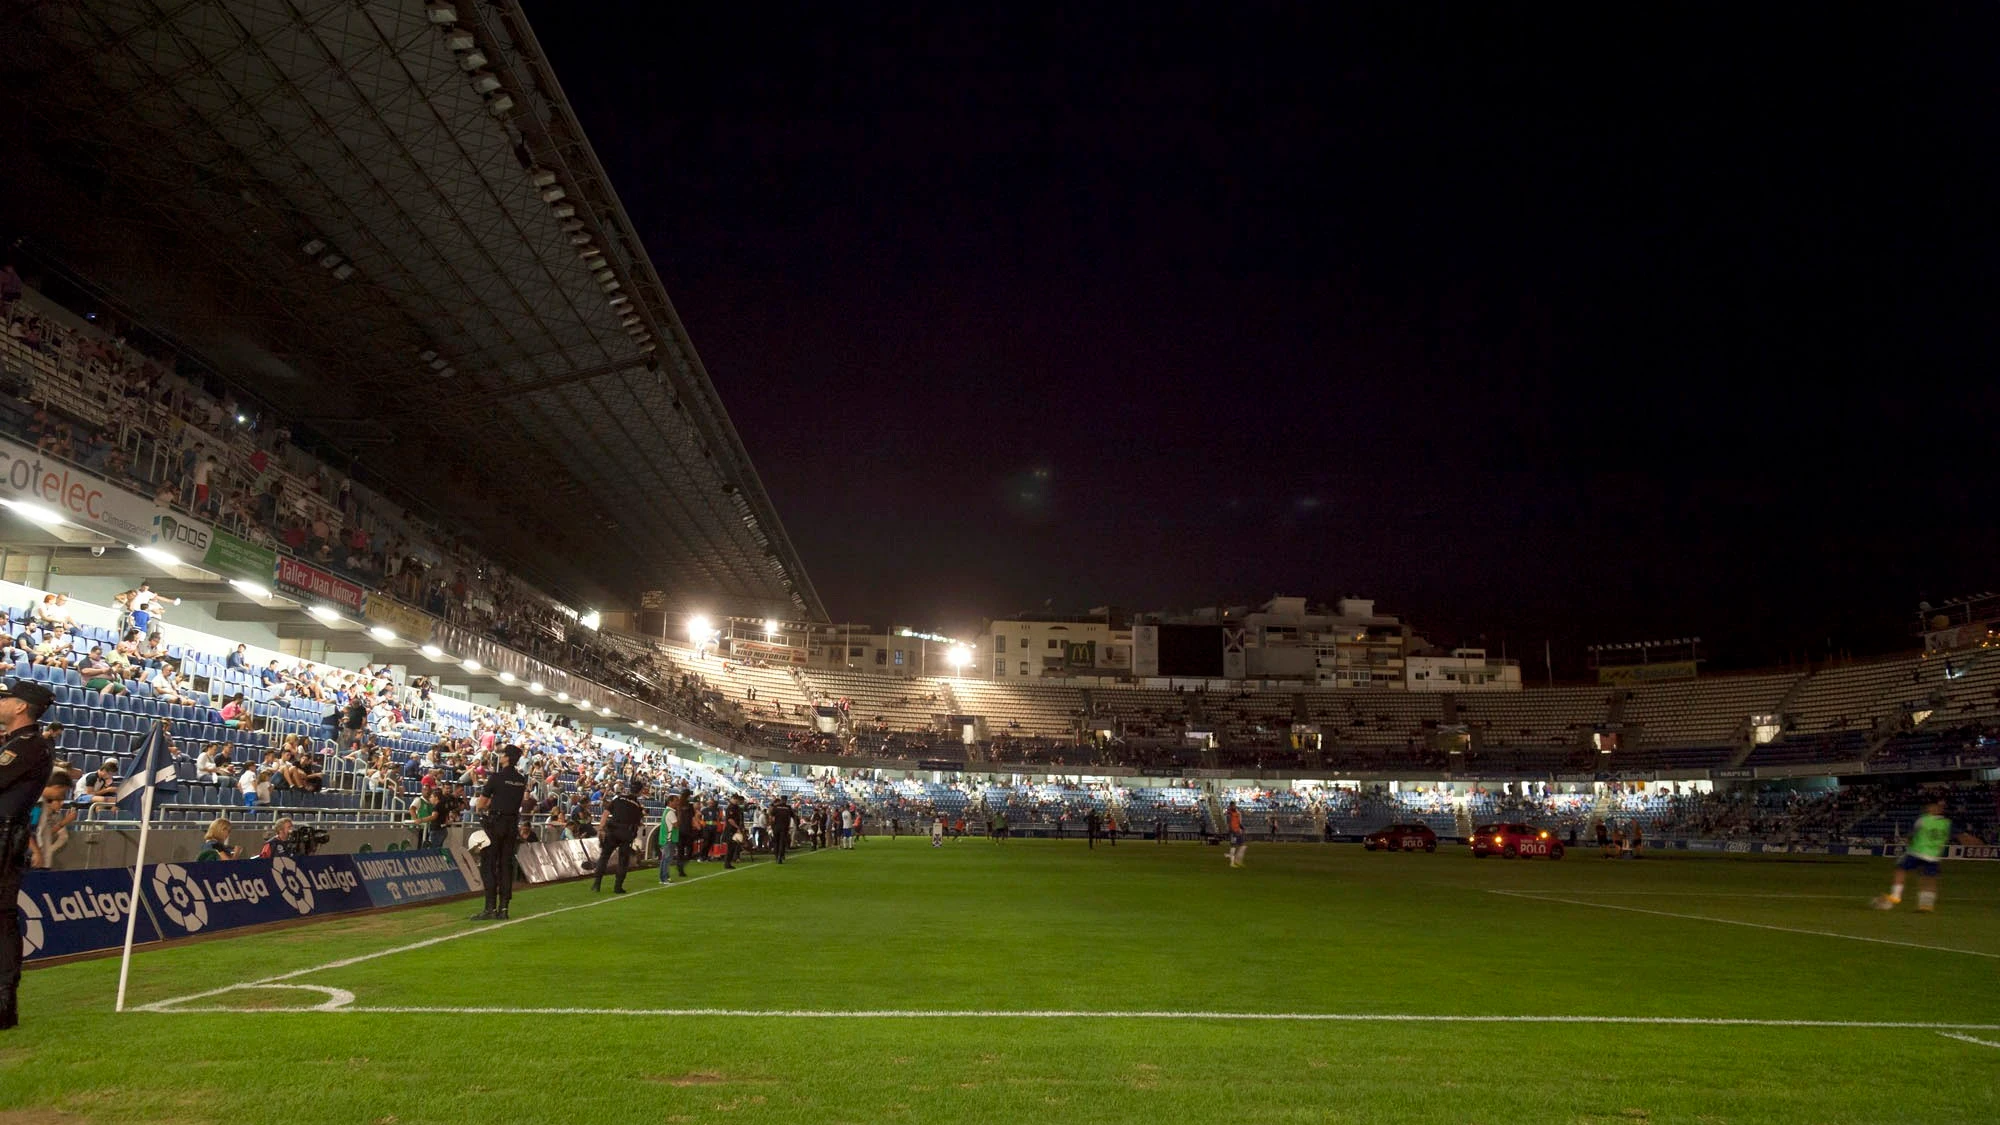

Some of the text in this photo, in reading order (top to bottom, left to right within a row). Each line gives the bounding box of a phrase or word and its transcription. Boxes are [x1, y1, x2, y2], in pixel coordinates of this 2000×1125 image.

[282, 560, 307, 586] Taller
[309, 571, 330, 595] Juan
[332, 581, 358, 605] Gómez
[1402, 839, 1424, 848] POLO
[1520, 843, 1546, 854] POLO
[1967, 848, 2000, 858] SABA
[308, 865, 358, 893] LaLiga
[357, 858, 408, 881] LIMPIEZA
[203, 873, 270, 904] LaLiga
[42, 886, 131, 923] LaLiga
